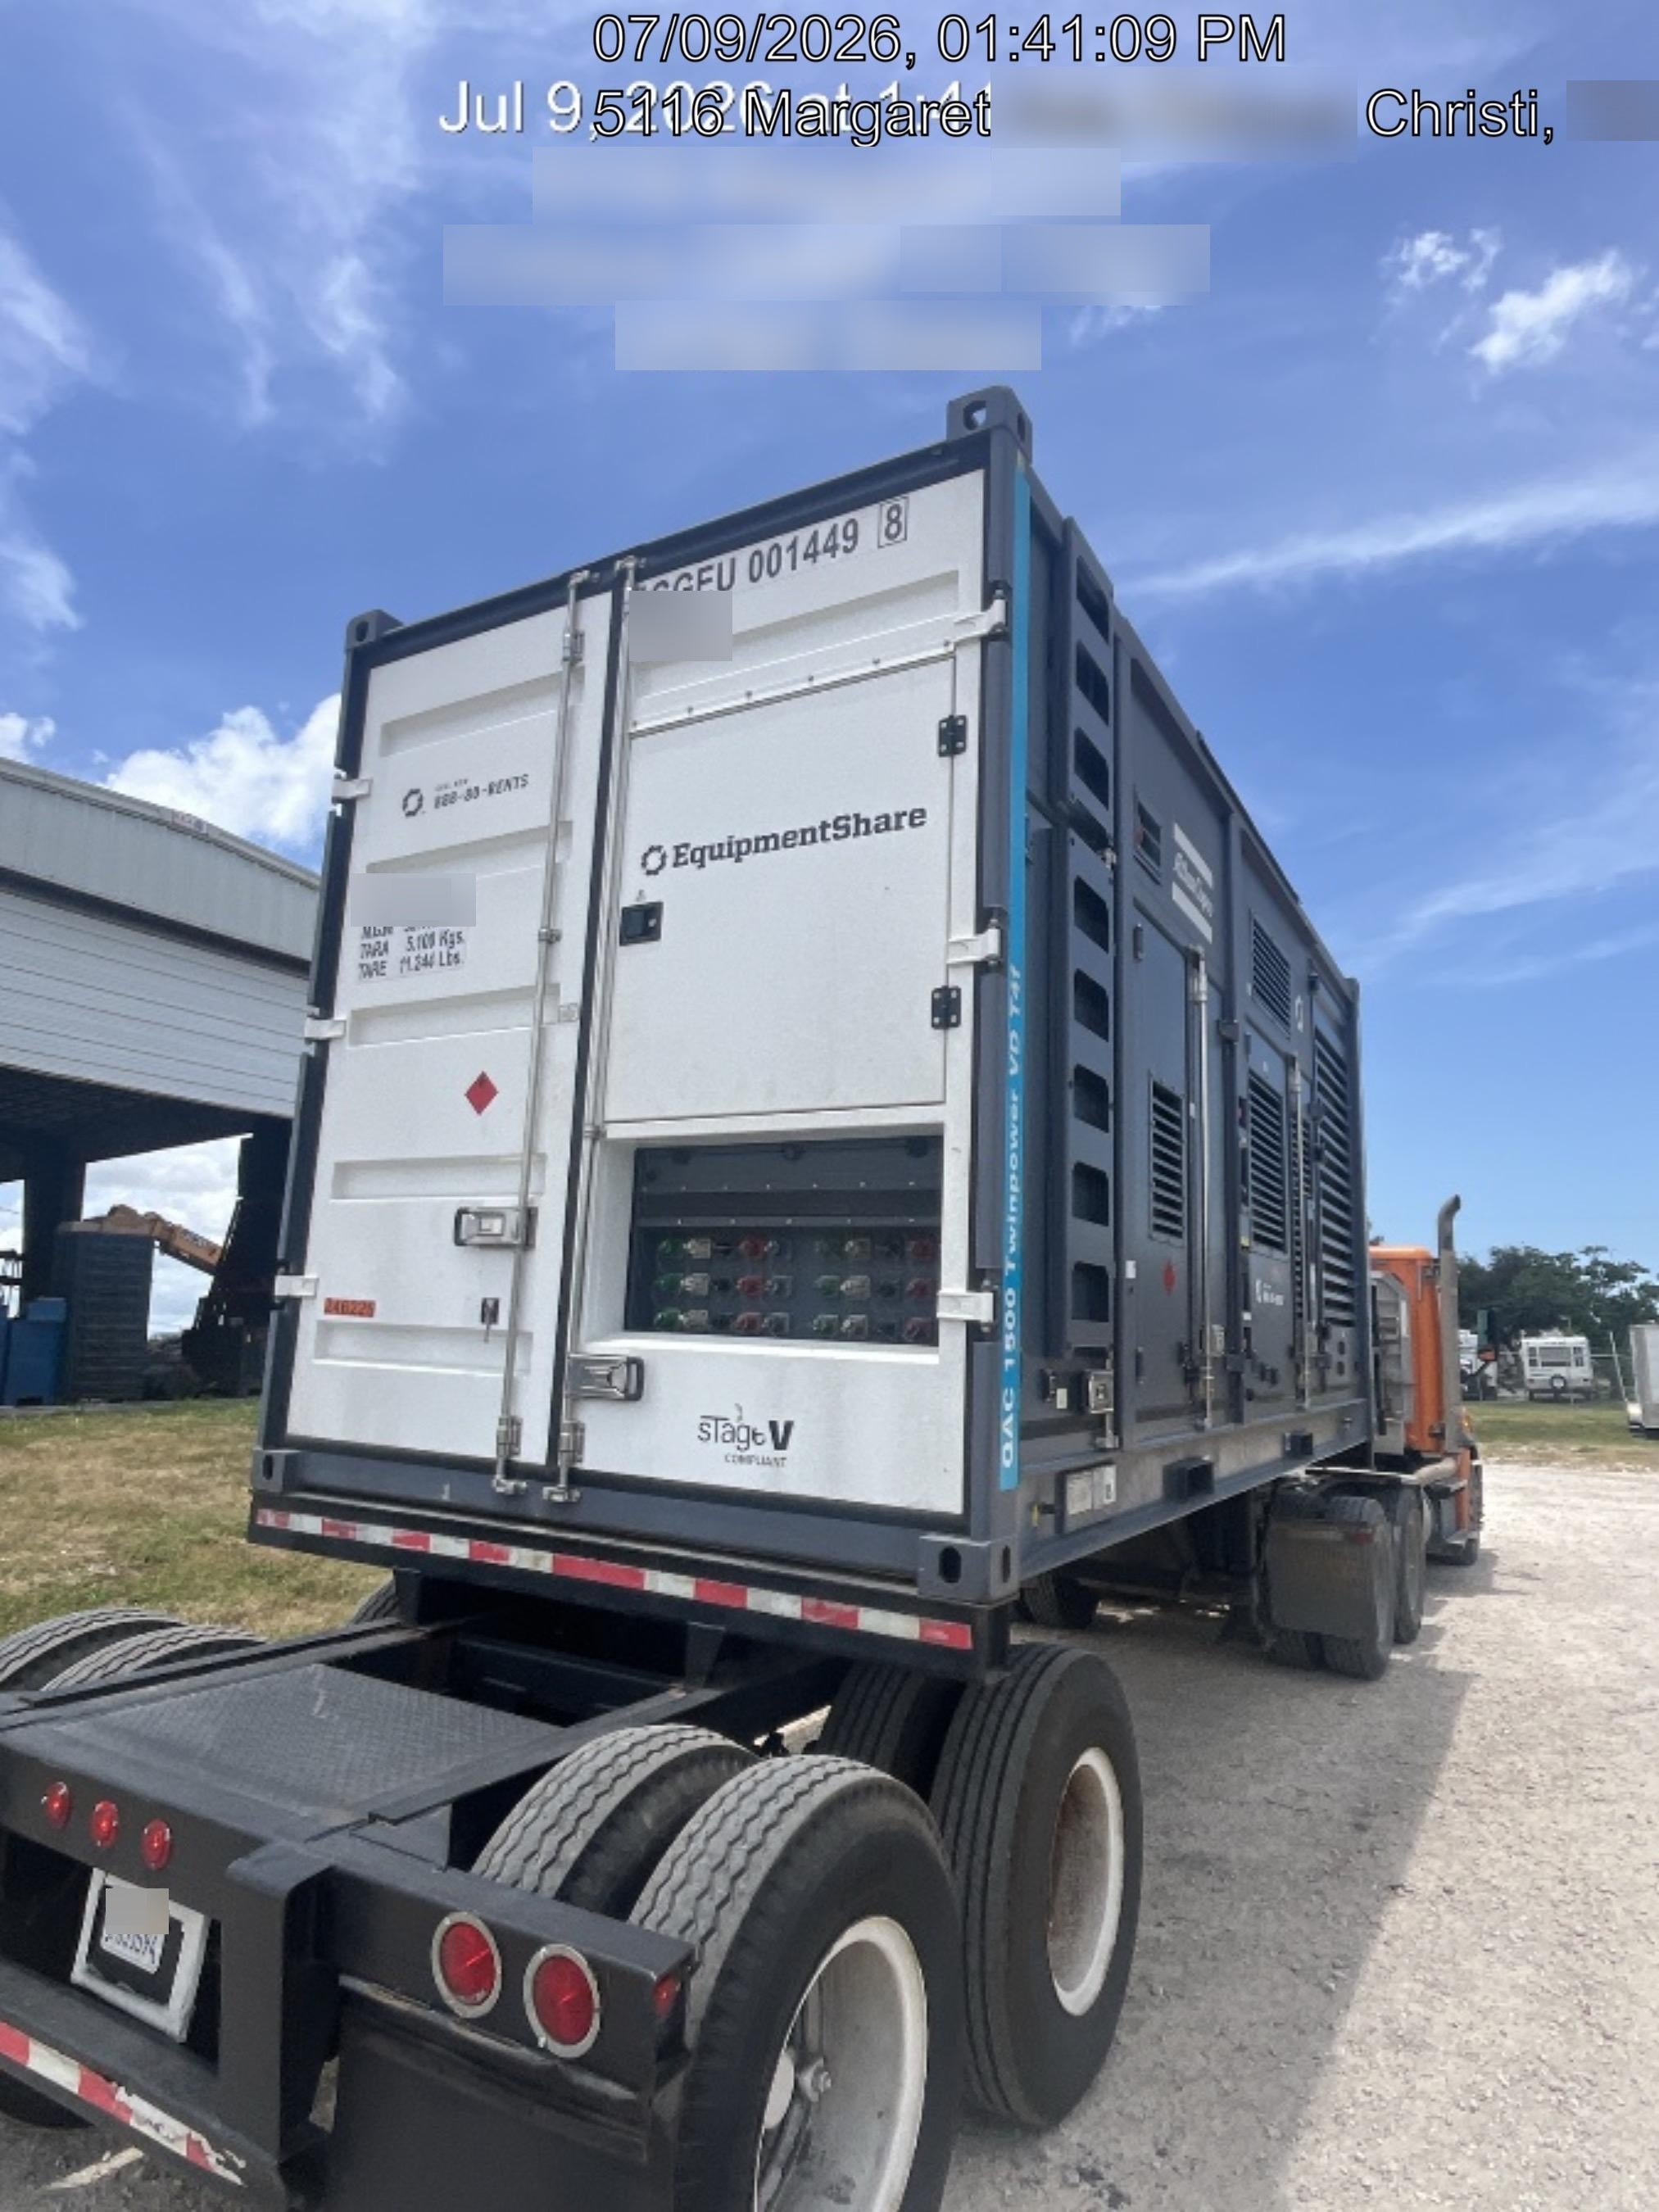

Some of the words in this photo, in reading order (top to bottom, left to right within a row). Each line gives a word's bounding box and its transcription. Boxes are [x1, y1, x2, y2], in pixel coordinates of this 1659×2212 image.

[748, 517, 859, 583] 001449
[884, 502, 903, 542] 8
[673, 807, 927, 869] EquipmentShare
[768, 1420, 794, 1451] V
[1002, 1387, 1015, 1469] QAC
